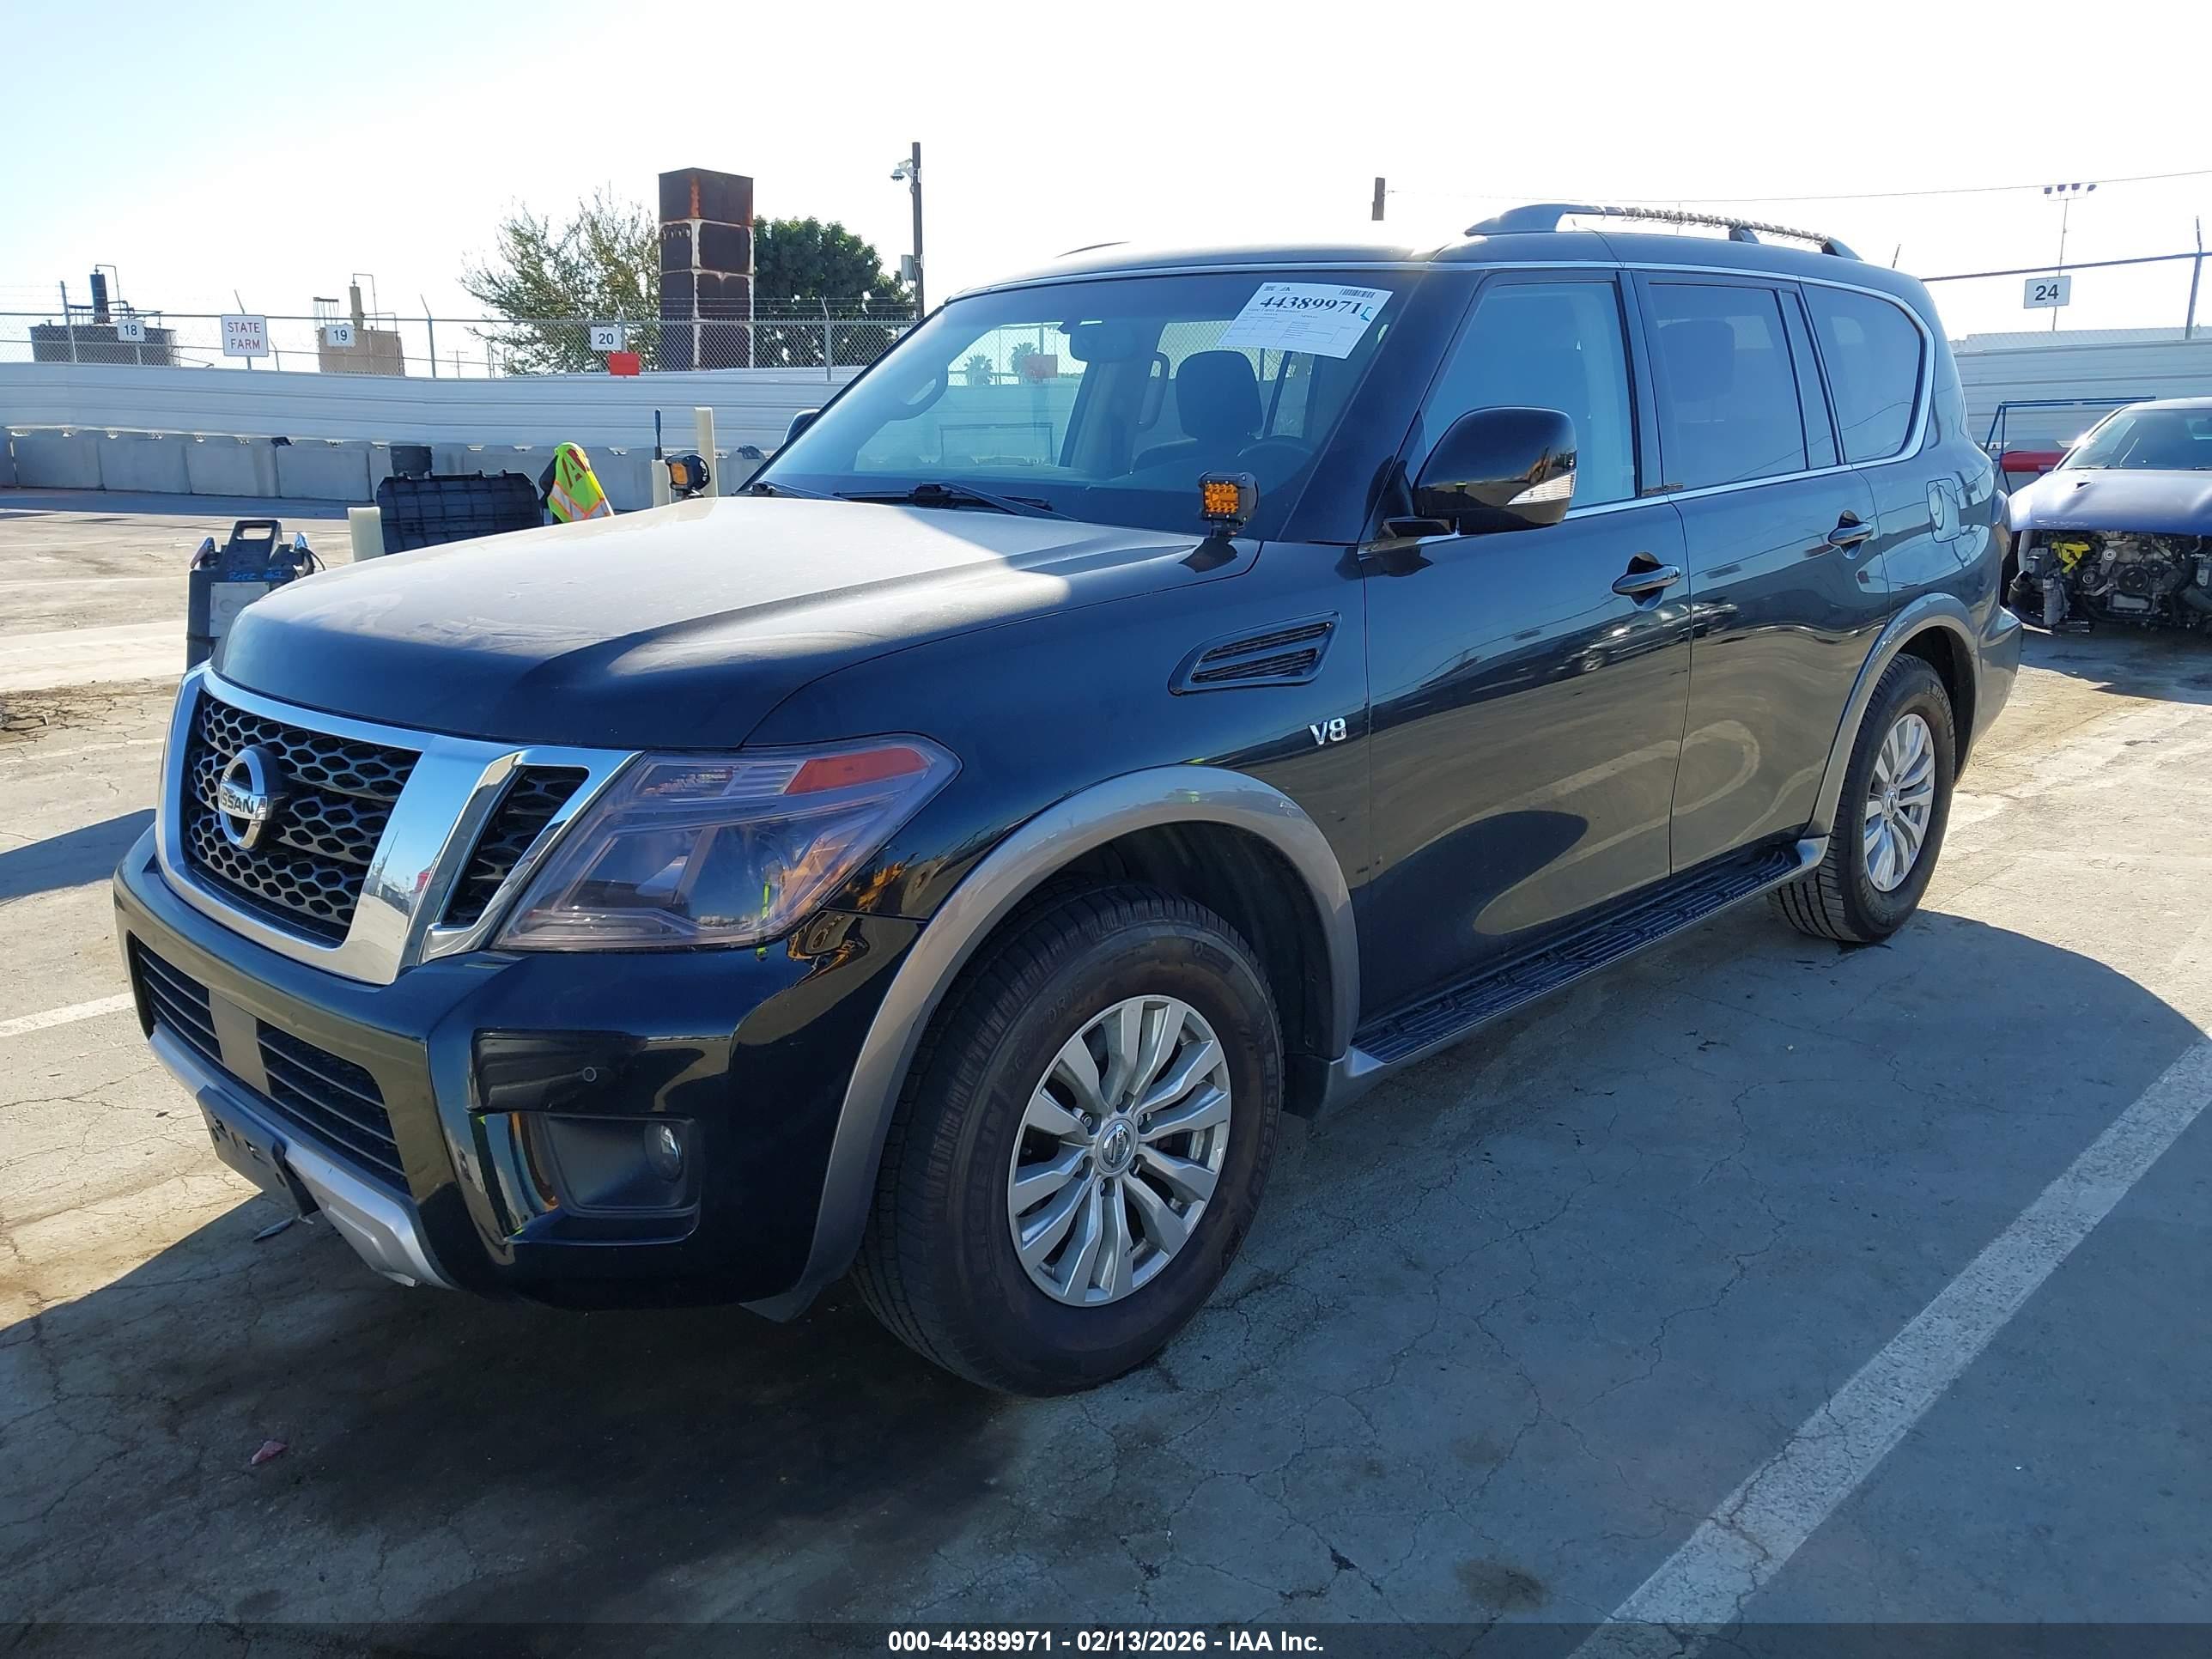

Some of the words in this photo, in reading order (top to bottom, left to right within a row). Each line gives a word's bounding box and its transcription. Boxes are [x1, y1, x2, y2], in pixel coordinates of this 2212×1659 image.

[2034, 284, 2059, 301] 24
[1260, 295, 1362, 314] 44389971
[124, 325, 137, 336] 18
[228, 322, 261, 333] STATE
[333, 329, 348, 341] 19
[598, 332, 614, 345] 20
[230, 338, 261, 349] FARM
[1309, 717, 1347, 745] V8
[220, 789, 255, 814] ISSAN
